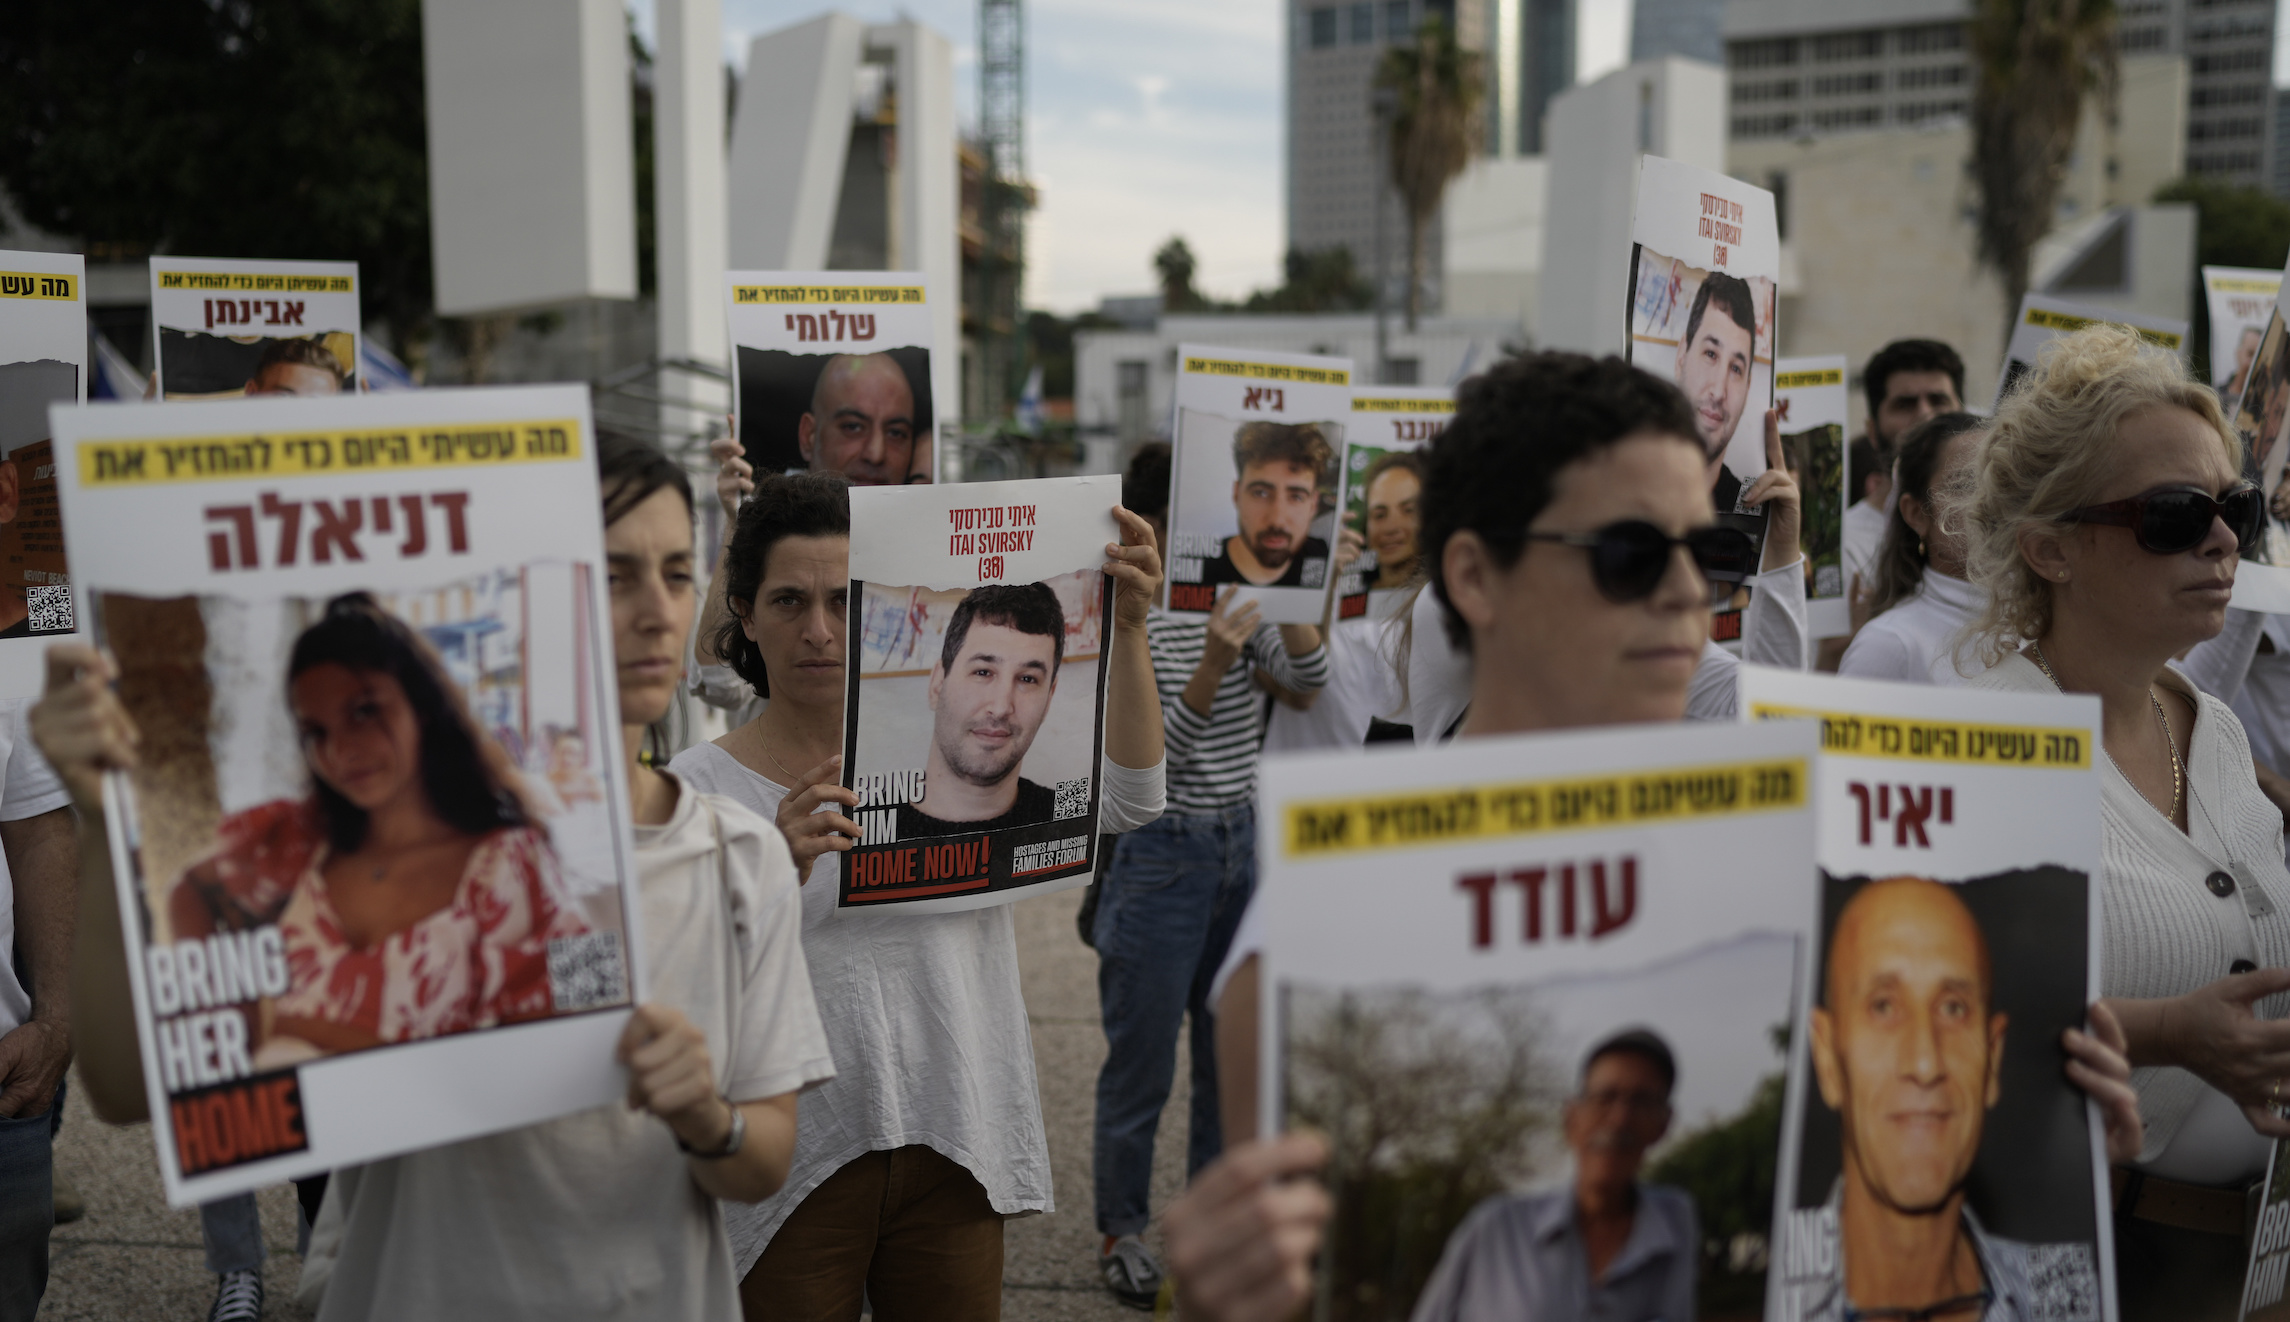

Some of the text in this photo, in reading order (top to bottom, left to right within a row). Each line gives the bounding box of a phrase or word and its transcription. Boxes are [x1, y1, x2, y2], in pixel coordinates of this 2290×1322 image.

[1698, 216, 1742, 247] ITAI SVIRSKY
[1, 275, 69, 297] מה עש
[162, 273, 183, 288] את
[186, 273, 230, 289] להחזיר
[233, 276, 253, 289] כדי
[256, 276, 284, 290] היום
[330, 279, 349, 291] מה
[737, 286, 920, 302] מה עשינו היום כדי להחזיר את
[204, 298, 305, 329] אבינתן
[785, 309, 876, 342] שלומי
[1243, 386, 1284, 412] גיא
[92, 426, 569, 481] מה עשיתי היום כדי להחזיר את
[205, 491, 471, 572] דניאלה
[949, 505, 1036, 533] איתי סבירסקי
[950, 530, 1034, 556] ITAI SVIRSKY
[1174, 534, 1223, 559] BRING
[23, 569, 47, 584] NEVIOT
[1171, 557, 1204, 584] HIM
[1170, 585, 1216, 611] HOME
[1821, 716, 2080, 763] מה עשינו היום כדי להח
[854, 768, 925, 809] BRING
[1751, 767, 1792, 804] מה
[1368, 786, 1477, 842] להחזיר
[1553, 783, 1617, 823] היום
[1848, 781, 1955, 849] יאיר
[853, 808, 898, 847] HIM
[1297, 810, 1349, 848] את
[850, 835, 992, 889] HOME NOW!
[1012, 846, 1087, 874] FAMILIES FORUM
[1013, 834, 1088, 858] HOSTAGES AND MISSING
[1454, 856, 1638, 950] עודד
[149, 926, 290, 1014] BRING
[159, 1011, 250, 1091] HER
[173, 1079, 302, 1173] HOME
[2259, 1200, 2290, 1256] BRI
[2247, 1250, 2290, 1313] HIM
